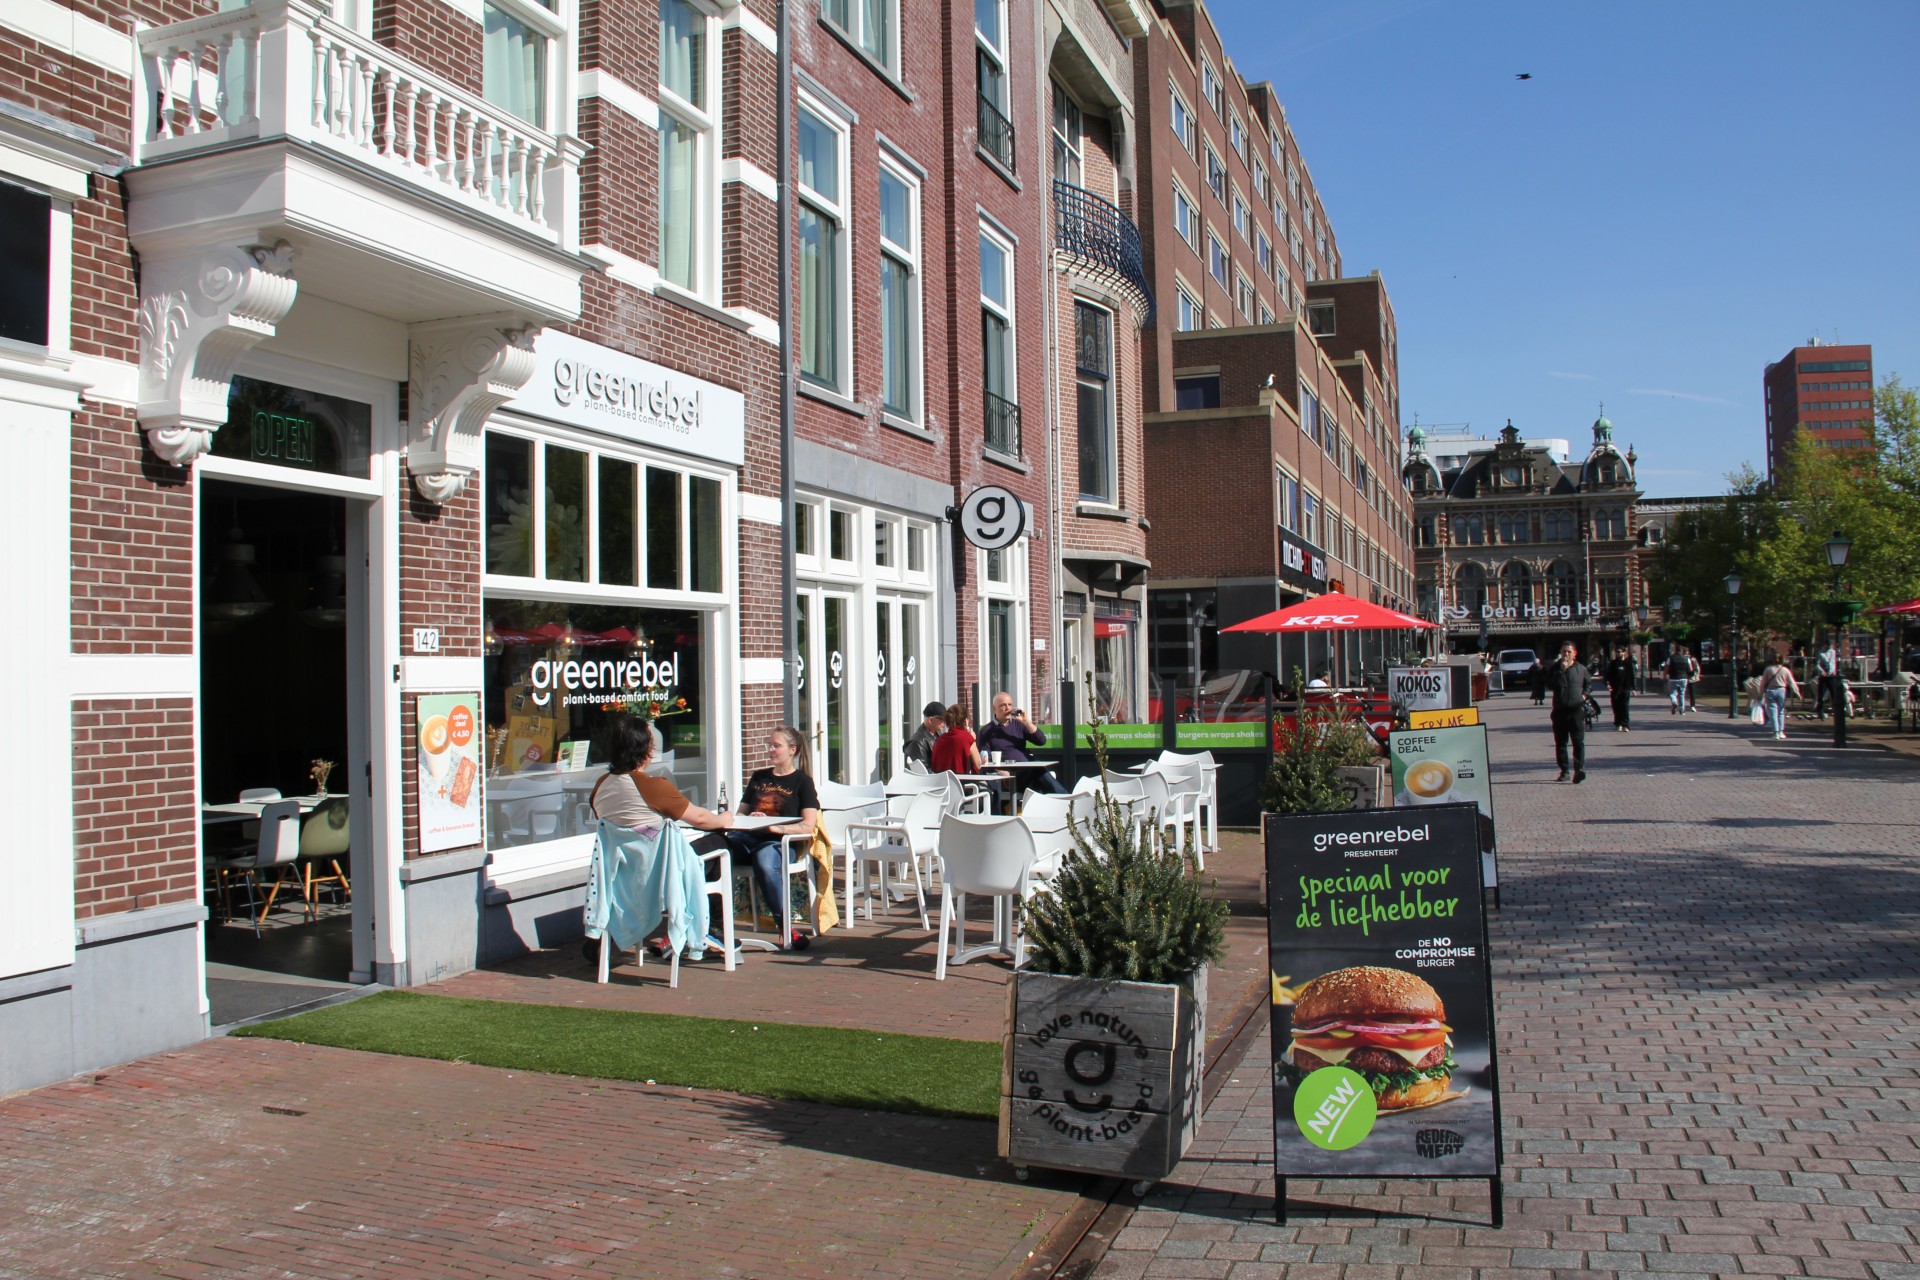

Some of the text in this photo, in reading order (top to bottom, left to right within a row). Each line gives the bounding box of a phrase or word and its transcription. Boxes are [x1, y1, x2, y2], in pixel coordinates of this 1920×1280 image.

[554, 358, 703, 428] greenrebel
[584, 399, 690, 435] plant-based comfort food
[255, 411, 313, 462] OPEN
[1481, 601, 1601, 620] Den Haag HS
[1280, 615, 1359, 626] KFC
[416, 631, 437, 649] 142
[531, 651, 679, 706] greenrebel
[1397, 675, 1442, 693] KOKOS
[562, 690, 669, 708] plant-based comfort food
[452, 712, 469, 720] coffee
[455, 720, 467, 728] deal
[1447, 714, 1466, 727] ME
[1109, 732, 1133, 741] wraps
[1134, 731, 1161, 739] shakes
[1178, 730, 1264, 741] burgers wraps shakes
[1397, 735, 1437, 746] COFFEE
[1398, 745, 1425, 754] DEAL
[1313, 824, 1430, 852] greenrebel
[1344, 848, 1399, 858] PRESENTEERT
[1400, 867, 1451, 887] voor
[1295, 889, 1459, 936] de liefhebber
[1418, 937, 1452, 947] DE NO
[1395, 947, 1476, 959] COMPROMISE
[1416, 958, 1455, 968] BURGER
[1029, 1012, 1073, 1049] love
[1080, 1009, 1150, 1061] nature
[1306, 1076, 1357, 1135] NEW
[1416, 1143, 1464, 1159] MEAT
